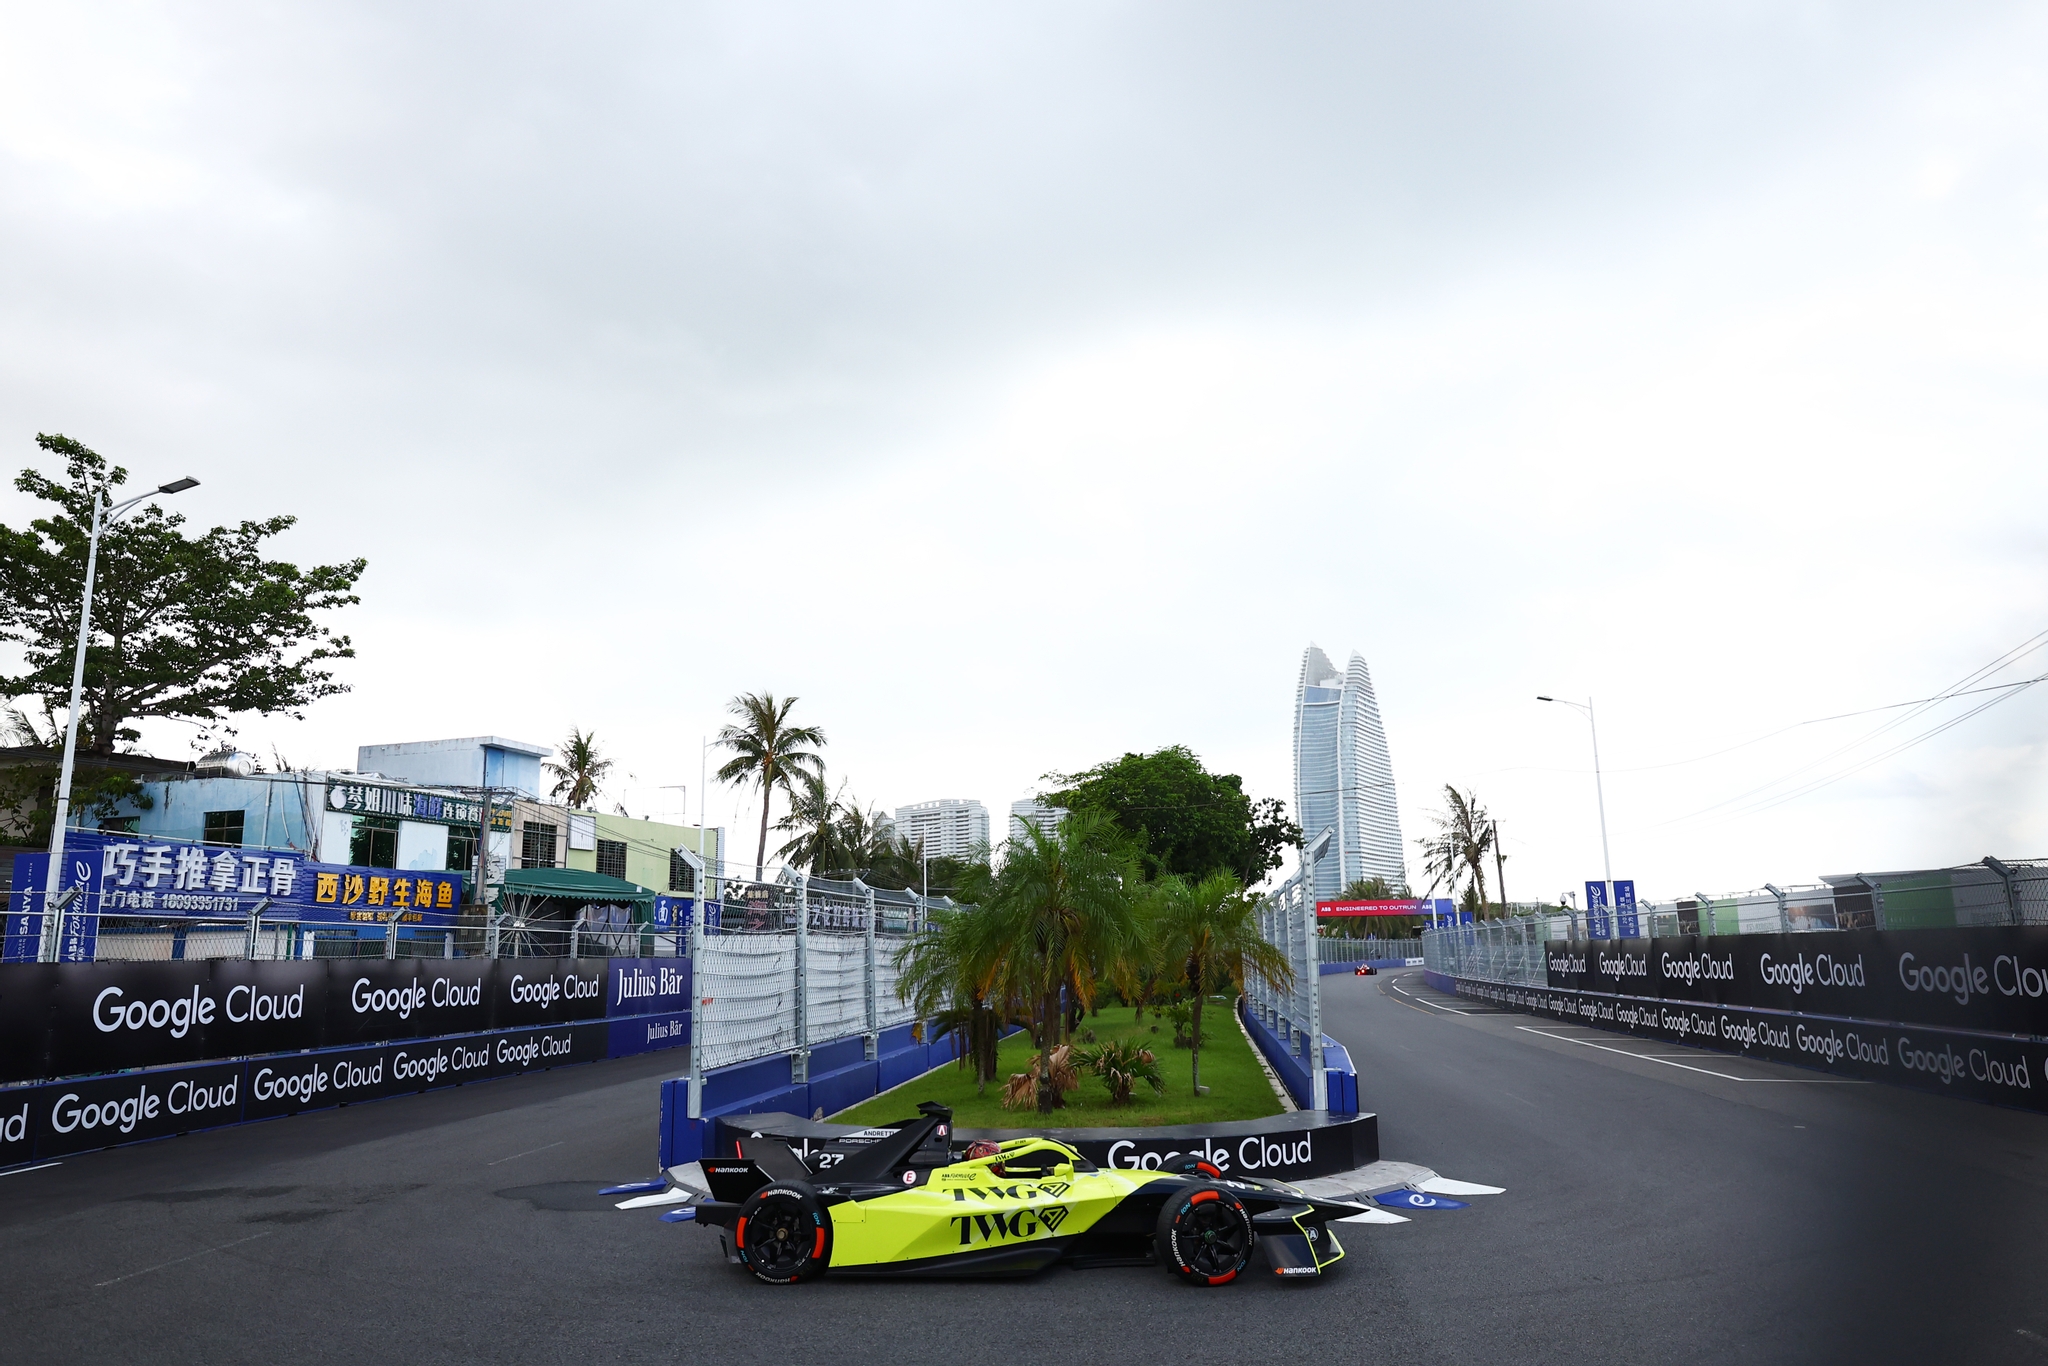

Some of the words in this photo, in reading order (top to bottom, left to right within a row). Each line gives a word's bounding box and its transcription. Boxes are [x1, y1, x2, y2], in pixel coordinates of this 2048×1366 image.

[347, 786, 482, 822] 琴姐川味海鲜连锁餐
[103, 843, 297, 896] 巧手推拿正骨
[315, 872, 453, 908] 西沙野生海鱼
[20, 886, 33, 935] SANYA
[1548, 951, 1569, 978] Google
[1569, 953, 1586, 973] Cloud
[1599, 952, 1625, 981] Google
[1625, 953, 1647, 976] Cloud
[1661, 952, 1700, 986] Google
[1701, 952, 1734, 980] Cloud
[1760, 952, 1814, 994] Google
[1815, 953, 1865, 987] Cloud
[1899, 952, 1990, 1006] Google
[1993, 954, 2048, 998] Clo
[352, 977, 426, 1020] Google
[432, 977, 481, 1008] Cloud
[511, 974, 560, 1009] Google
[564, 974, 599, 999] Cloud
[616, 968, 656, 1006] Julius
[659, 967, 683, 995] Bär
[93, 984, 216, 1038] Google
[226, 984, 304, 1023] Cloud
[1548, 994, 1564, 1016] Google
[1564, 997, 1577, 1015] Cloud
[1578, 998, 1598, 1022] Google
[1597, 1001, 1614, 1020] Cloud
[1616, 1002, 1639, 1029] Google
[1639, 1006, 1658, 1027] Cloud
[1661, 1008, 1690, 1038] Google
[1691, 1012, 1717, 1036] Cloud
[497, 1037, 539, 1066] Google
[541, 1033, 571, 1057] Cloud
[647, 1023, 669, 1044] Julius
[669, 1020, 683, 1038] Bär
[1720, 1015, 1757, 1049] Google
[1758, 1021, 1791, 1049] Cloud
[1796, 1024, 1844, 1064] Google
[1846, 1032, 1889, 1065] Cloud
[254, 1063, 328, 1104] Google
[333, 1057, 383, 1090] Cloud
[394, 1048, 448, 1082] Google
[451, 1043, 490, 1071] Cloud
[1897, 1036, 1966, 1085] Google
[1968, 1048, 2031, 1089] Cloud
[52, 1084, 160, 1134] Google
[167, 1075, 238, 1114] Cloud
[819, 1153, 845, 1169] 27
[1107, 1138, 1230, 1172] Gole
[1238, 1131, 1312, 1170] Cloud
[942, 1183, 1037, 1202] TWG
[950, 1209, 1037, 1245] TWG
